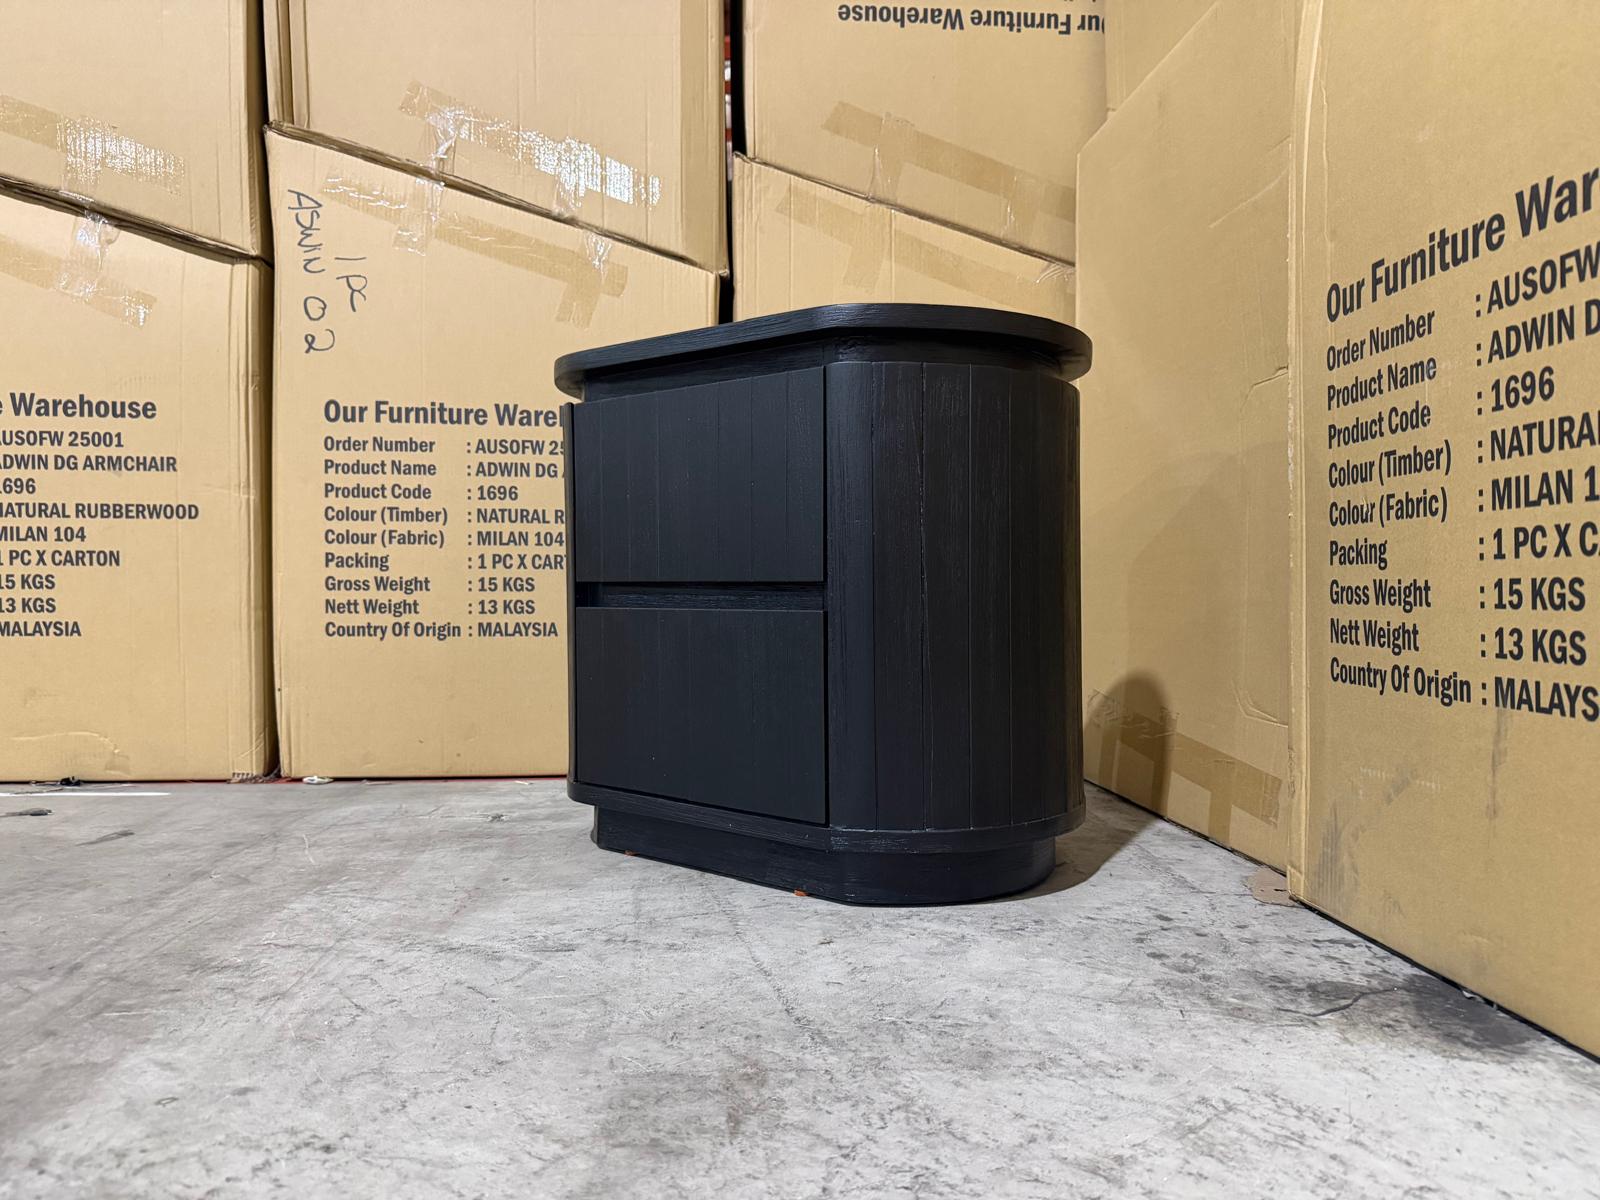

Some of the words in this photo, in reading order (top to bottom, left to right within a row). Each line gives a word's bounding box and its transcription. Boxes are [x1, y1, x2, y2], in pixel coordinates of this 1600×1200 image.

[838, 5, 964, 30] Warehouse
[971, 10, 1071, 35] Furniture
[1077, 14, 1105, 34] ur
[1326, 278, 1364, 323] Our
[1371, 213, 1505, 303] Furniture
[1326, 337, 1366, 371] Order
[1369, 310, 1435, 355] Number
[1487, 241, 1600, 314] AUSOFW
[1327, 368, 1383, 411] Product
[1387, 356, 1437, 392] Name
[1488, 305, 1575, 364] ADWIN
[10, 393, 156, 419] Warehouse
[325, 400, 368, 422] Our
[376, 401, 487, 425] Furniture
[1328, 411, 1384, 449] Product
[1388, 400, 1431, 435] Code
[1491, 365, 1555, 413] 1696
[0, 430, 64, 446] USOFW
[69, 431, 123, 447] 25001
[324, 436, 368, 451] Order
[373, 437, 435, 452] Number
[475, 439, 545, 455] AUSOFW
[0, 454, 48, 470] DWIN
[54, 455, 78, 470] DG
[83, 455, 177, 471] ARMCHAIR
[325, 459, 386, 474] Product
[391, 460, 436, 475] Name
[476, 462, 530, 477] ADWIN
[536, 463, 557, 478] DG
[1329, 459, 1375, 488] Colour
[1379, 437, 1451, 486] (Timber)
[0, 478, 35, 494] 696
[325, 483, 387, 498] Product
[391, 484, 431, 499] Code
[478, 486, 518, 500] 1696
[1329, 499, 1375, 527] Colour
[1379, 486, 1448, 528] (Fabric)
[1491, 468, 1573, 511] MILAN
[76, 503, 198, 519] RUBBERWOOD
[325, 506, 376, 521] Colour
[381, 507, 447, 525] (Timber)
[477, 508, 550, 523] NATURAL
[54, 527, 86, 542] 104
[325, 529, 377, 544] Colour
[382, 530, 444, 548] (Fabric)
[478, 531, 528, 546] MILAN
[534, 531, 564, 547] 104
[1330, 537, 1387, 570] Packing
[1493, 528, 1506, 560] 1
[1514, 524, 1547, 560] PC
[1554, 522, 1572, 558] X
[1579, 521, 1600, 557] C
[9, 550, 31, 566] PC
[36, 550, 46, 566] X
[51, 550, 119, 566] CARTON
[325, 552, 389, 571] Packing
[478, 554, 487, 569] 1
[493, 554, 513, 569] PC
[517, 554, 527, 569] X
[21, 574, 55, 589] KGS
[325, 576, 370, 591] Gross
[374, 576, 430, 595] Weight
[479, 577, 497, 592] 15
[503, 577, 535, 592] KGS
[1330, 579, 1369, 605] Gross
[1373, 578, 1431, 613] Weight
[1494, 577, 1523, 610] 15
[1531, 576, 1586, 612] KGS
[22, 598, 56, 613] KGS
[326, 599, 359, 614] Nett
[363, 599, 419, 617] Weight
[479, 600, 497, 614] 13
[504, 600, 535, 614] KGS
[0, 621, 81, 636] MALAYSIA
[325, 622, 387, 641] Country
[392, 622, 410, 636] Of
[414, 622, 460, 641] Origin
[478, 622, 558, 637] MALAYSIA
[1330, 618, 1360, 646] Nett
[1363, 619, 1419, 656] Weight
[1495, 627, 1524, 661] 13
[1532, 628, 1587, 666] KGS
[1330, 656, 1387, 695] Country
[1391, 664, 1410, 694] Of
[1414, 667, 1472, 707] Origin
[1494, 675, 1599, 723] MALAYS
